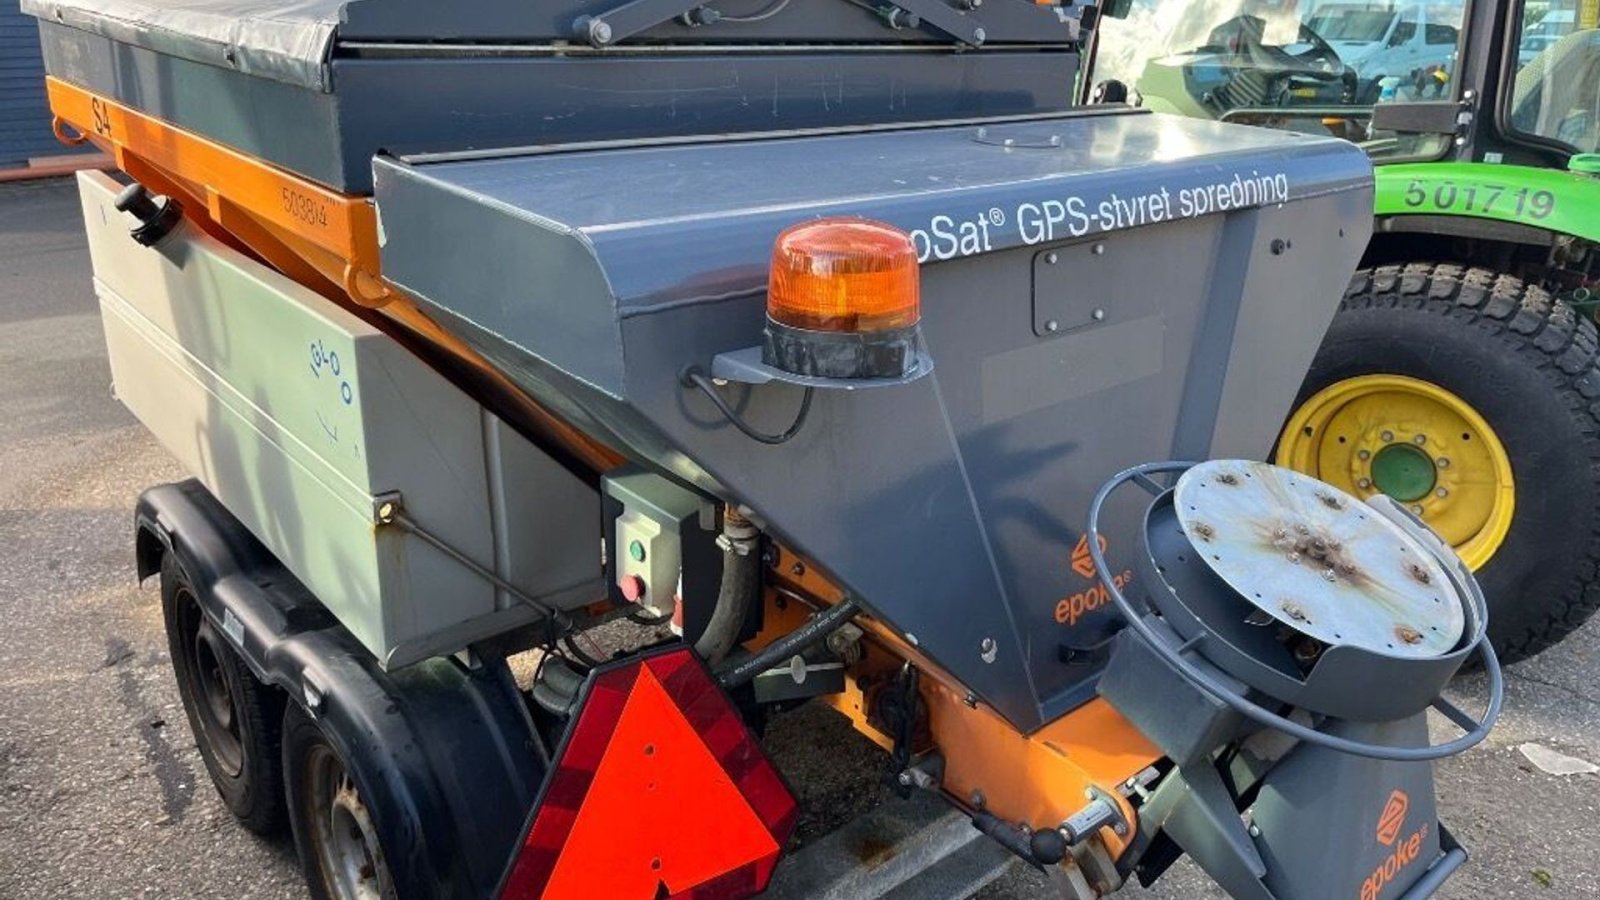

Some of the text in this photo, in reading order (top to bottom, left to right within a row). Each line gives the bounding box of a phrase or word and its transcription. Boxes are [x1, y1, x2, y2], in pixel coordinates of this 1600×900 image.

[91, 97, 112, 138] S4
[1179, 170, 1289, 218] spredning
[310, 338, 352, 405] IGLOO
